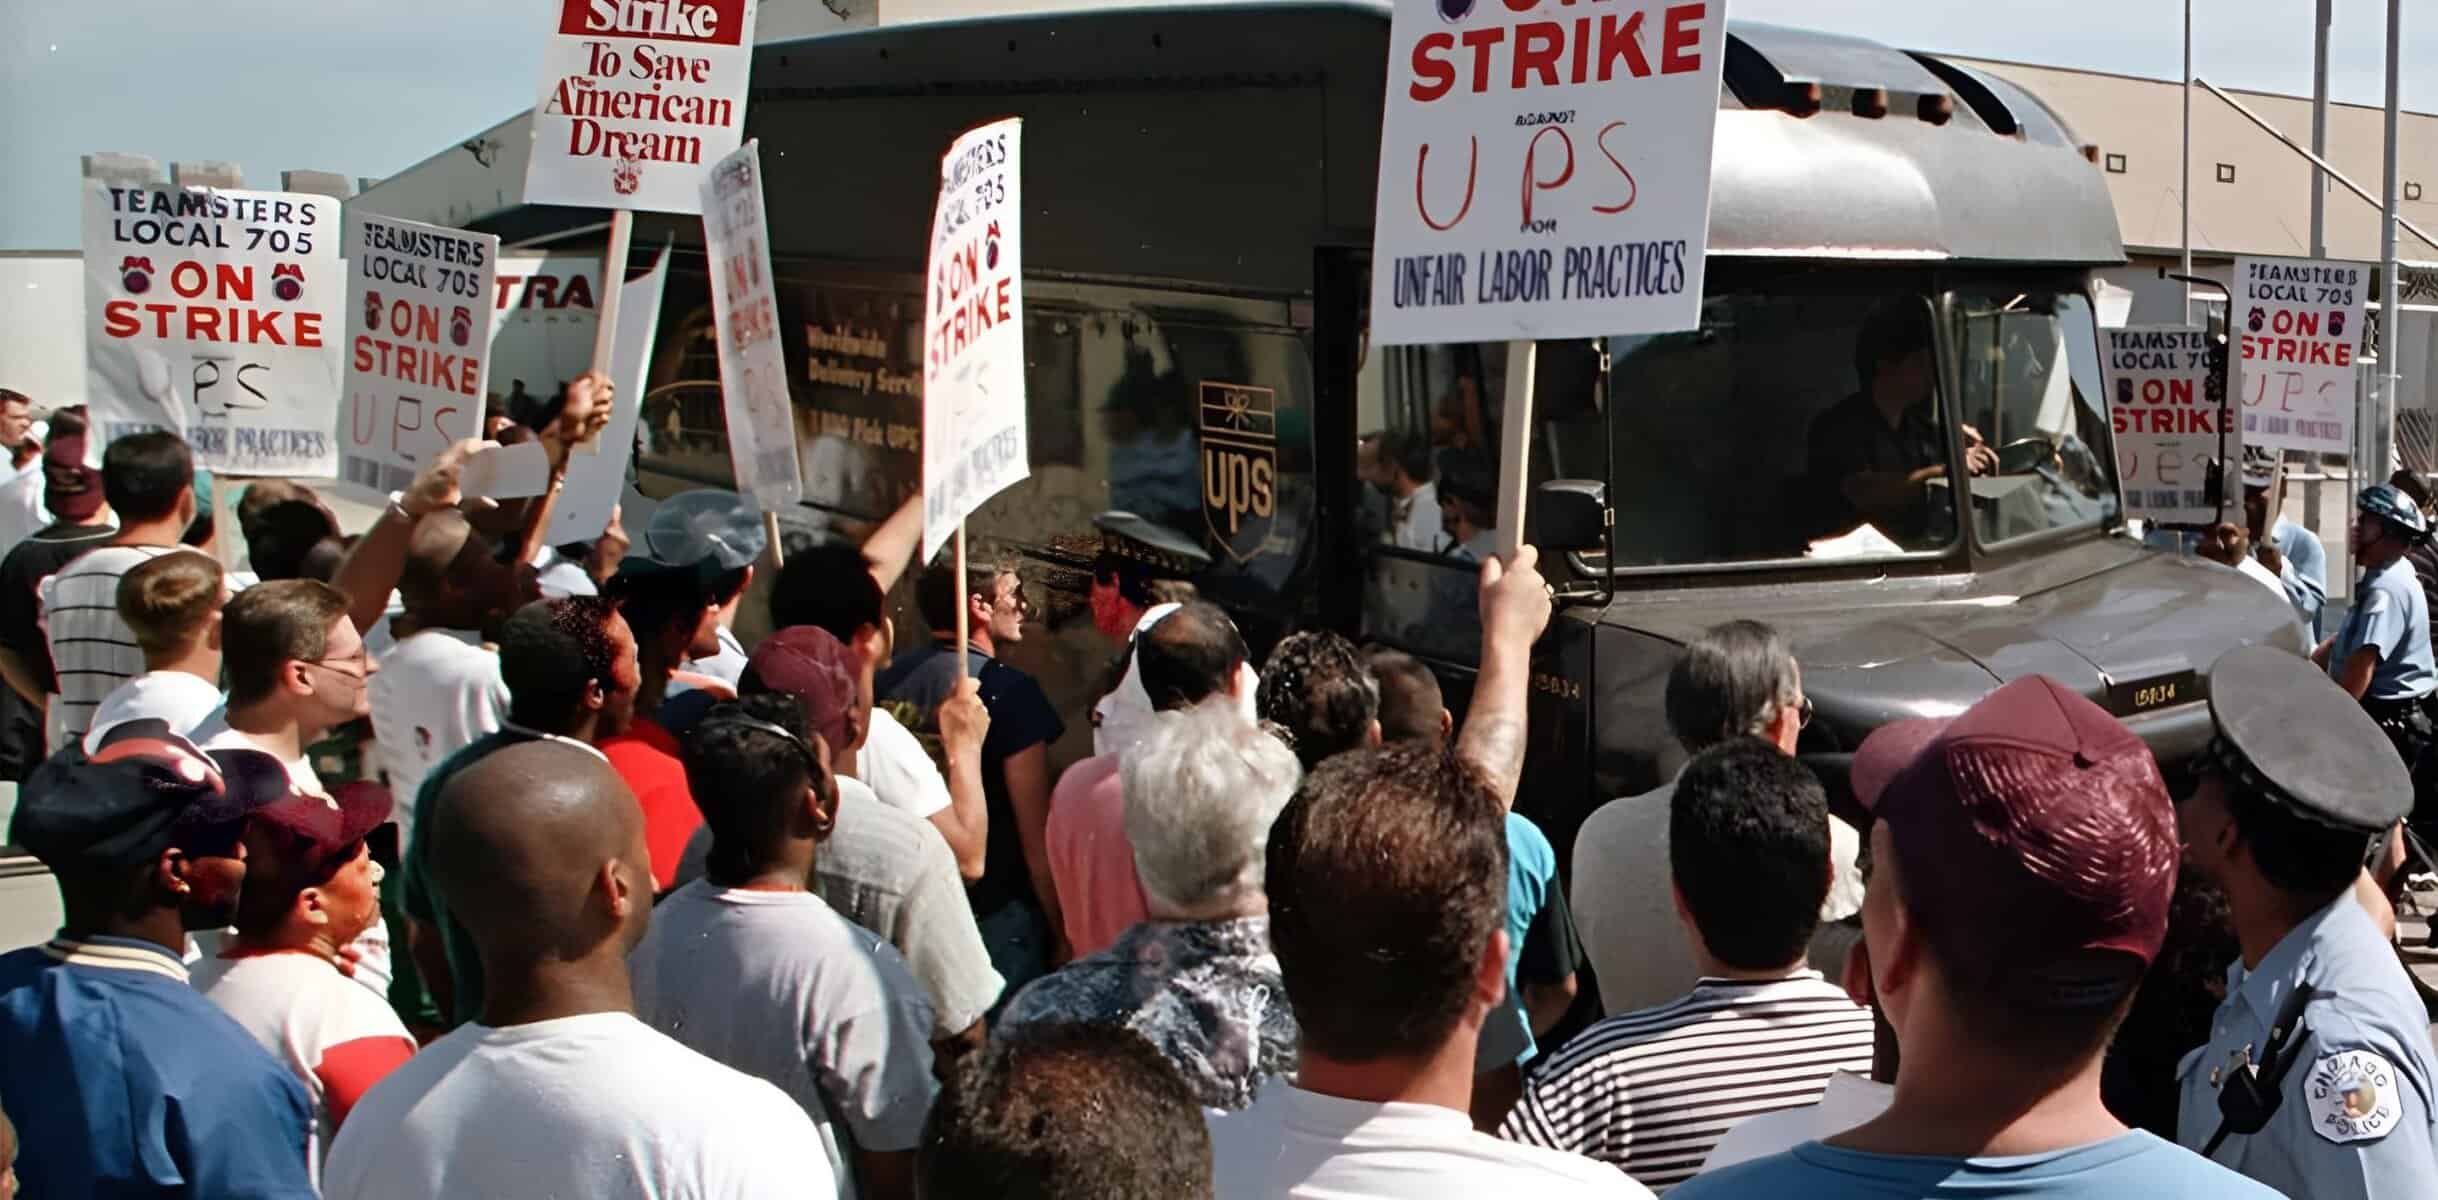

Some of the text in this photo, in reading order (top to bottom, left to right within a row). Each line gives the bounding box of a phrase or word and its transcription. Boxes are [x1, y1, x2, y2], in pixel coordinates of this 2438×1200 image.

[586, 0, 718, 38] Strike
[582, 42, 711, 84] To Save
[1408, 3, 1706, 102] STRIKE
[544, 82, 732, 127] American
[569, 118, 703, 164] Dream
[1416, 121, 1637, 231] UPS
[109, 187, 317, 226] TEAMSTERS
[113, 216, 313, 255] LOCAL 705
[364, 222, 485, 267] TEAMSTERS
[170, 260, 254, 302] ON
[363, 254, 480, 298] LOCAL 705
[950, 238, 979, 301] ON
[1393, 239, 1687, 309] UNFAIR LABOR PRACTICES
[2248, 283, 2308, 303] LOCAL
[104, 301, 323, 348] STRIKE
[390, 301, 441, 344] ON
[930, 276, 1012, 383] STRIKE
[2271, 309, 2320, 336] ON
[353, 335, 480, 396] STRIKE
[2112, 351, 2210, 369] LOCAL 70
[2241, 335, 2352, 367] STRIKE
[2141, 378, 2193, 405] ON
[2112, 407, 2234, 435] STRIKE
[1206, 447, 1273, 534] ups
